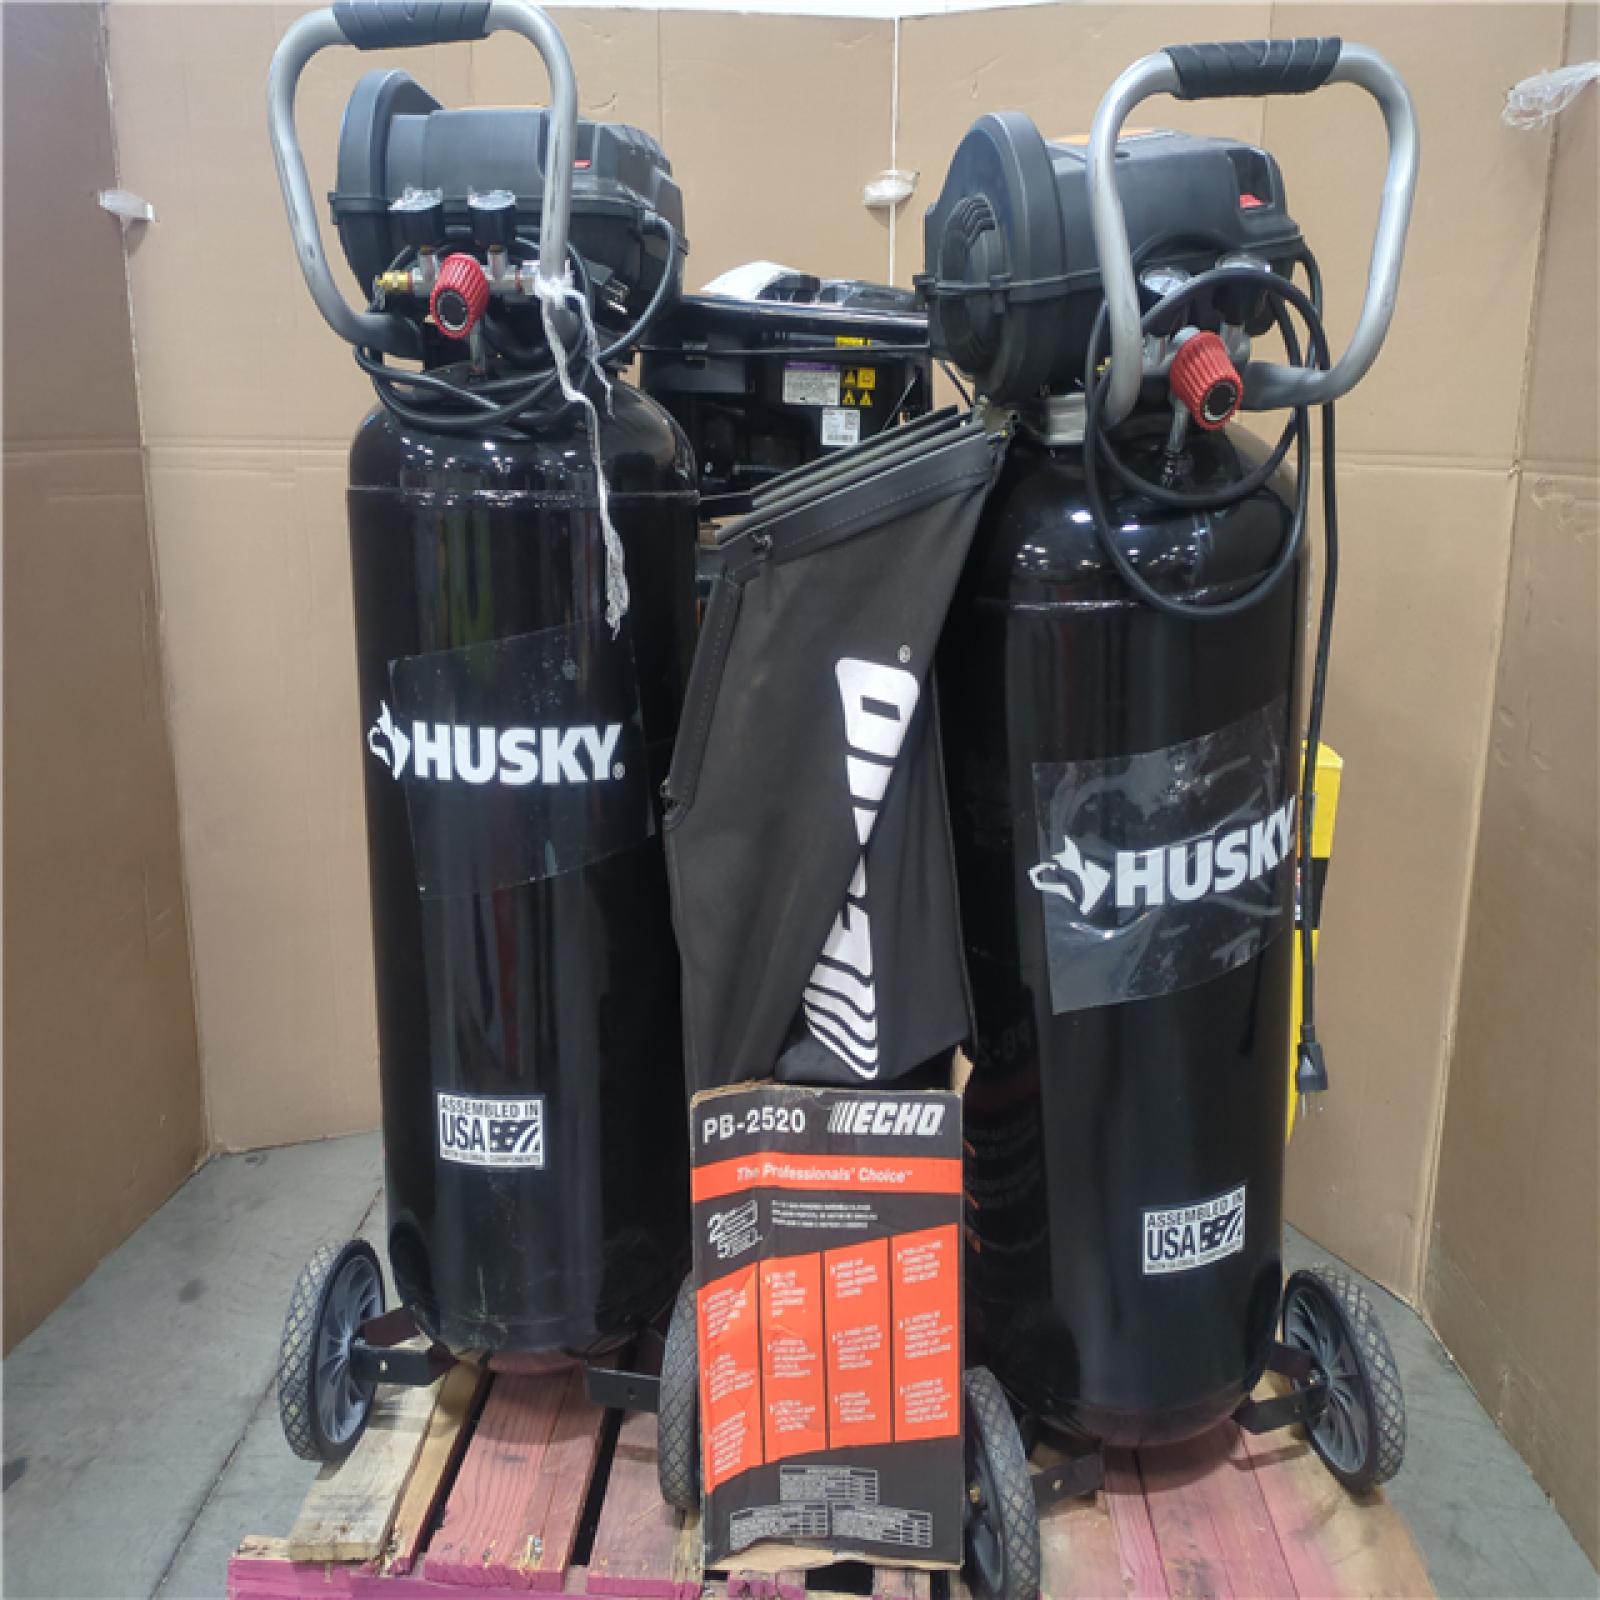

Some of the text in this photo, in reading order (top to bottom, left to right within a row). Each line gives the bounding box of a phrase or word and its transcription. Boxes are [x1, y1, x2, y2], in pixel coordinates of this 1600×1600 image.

[411, 720, 625, 786] HUSKY
[441, 1111, 486, 1151] USA
[702, 1103, 807, 1144] PB-2520
[848, 1101, 946, 1137] ECHO
[1147, 1223, 1197, 1261] USA
